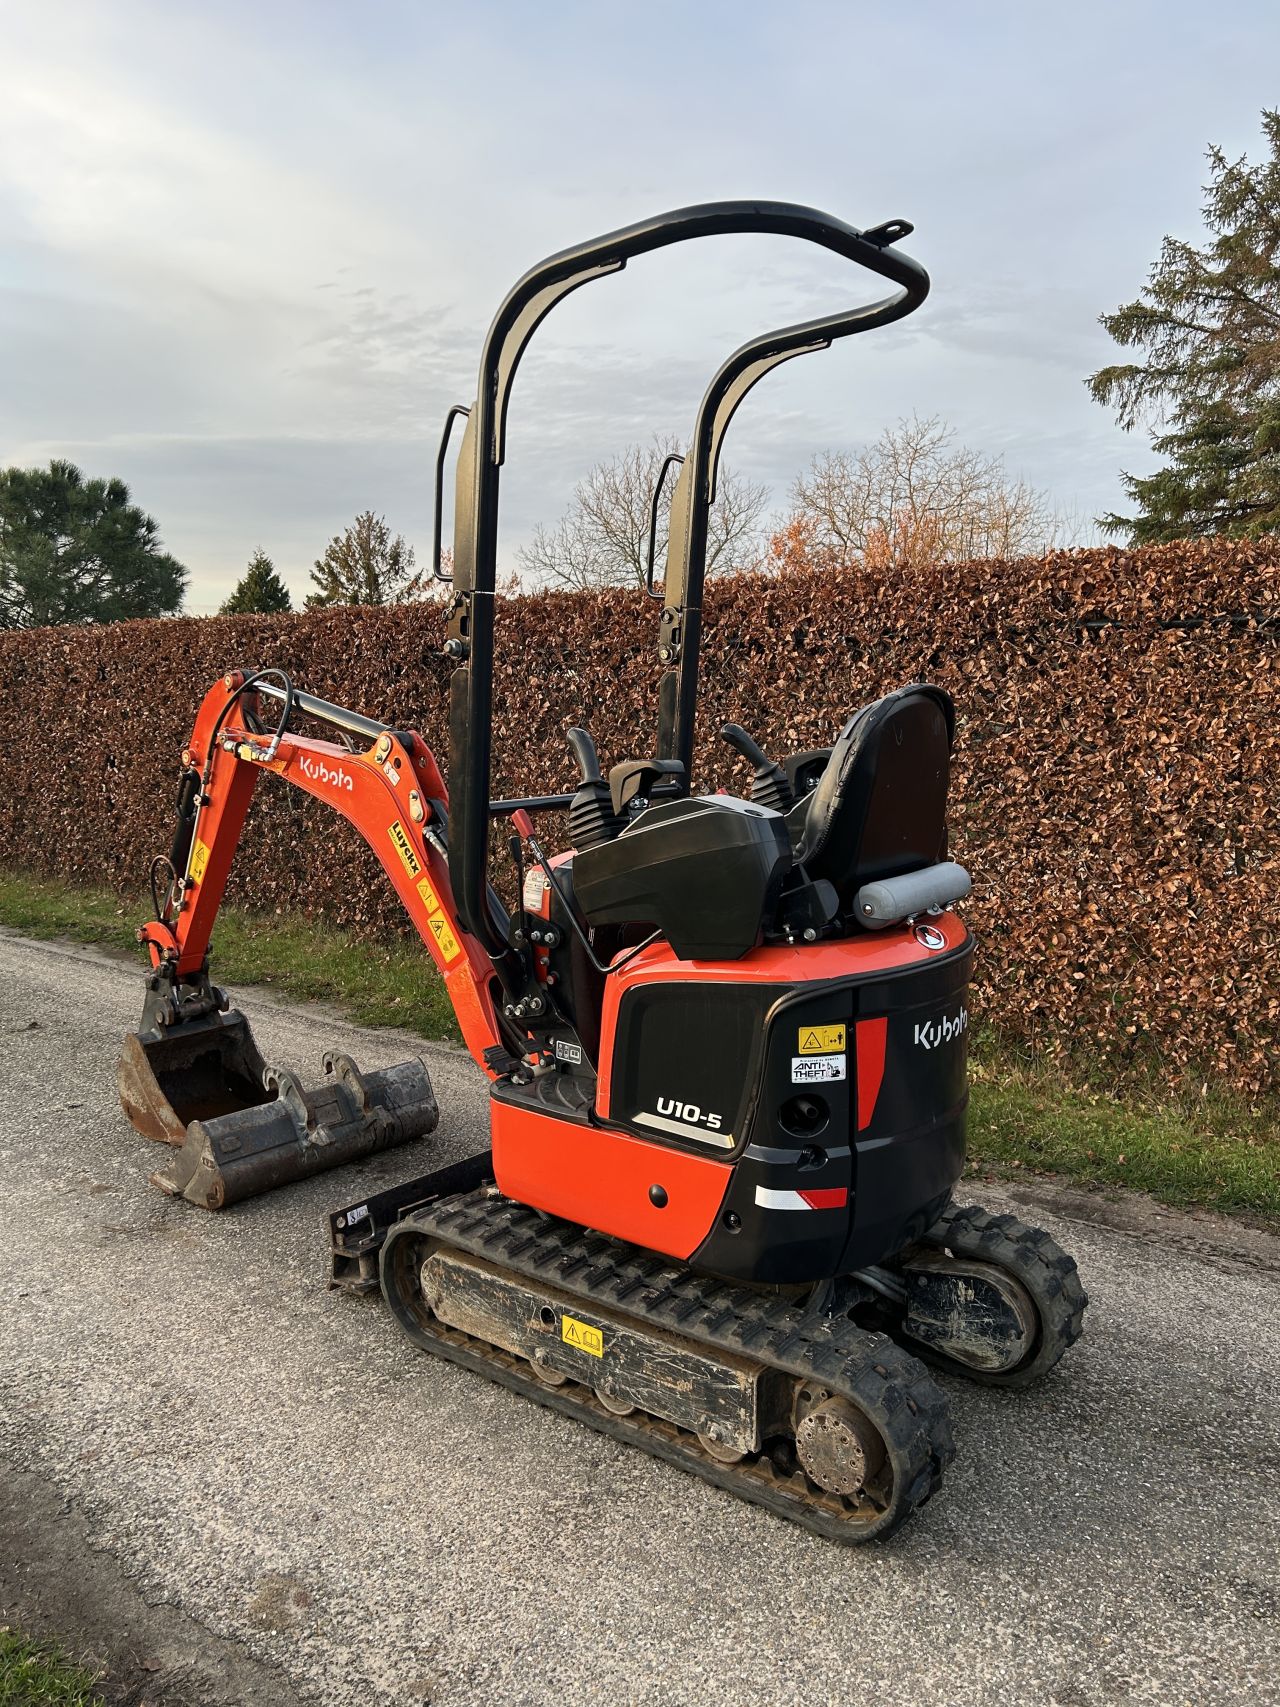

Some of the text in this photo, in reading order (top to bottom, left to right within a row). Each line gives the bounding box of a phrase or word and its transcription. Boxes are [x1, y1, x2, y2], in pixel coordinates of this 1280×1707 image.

[300, 756, 353, 791] Kubota
[392, 822, 420, 874] Luyckx
[914, 1005, 968, 1050] Kubota
[793, 1069, 827, 1078] THEFT
[656, 1096, 723, 1129] U10-5
